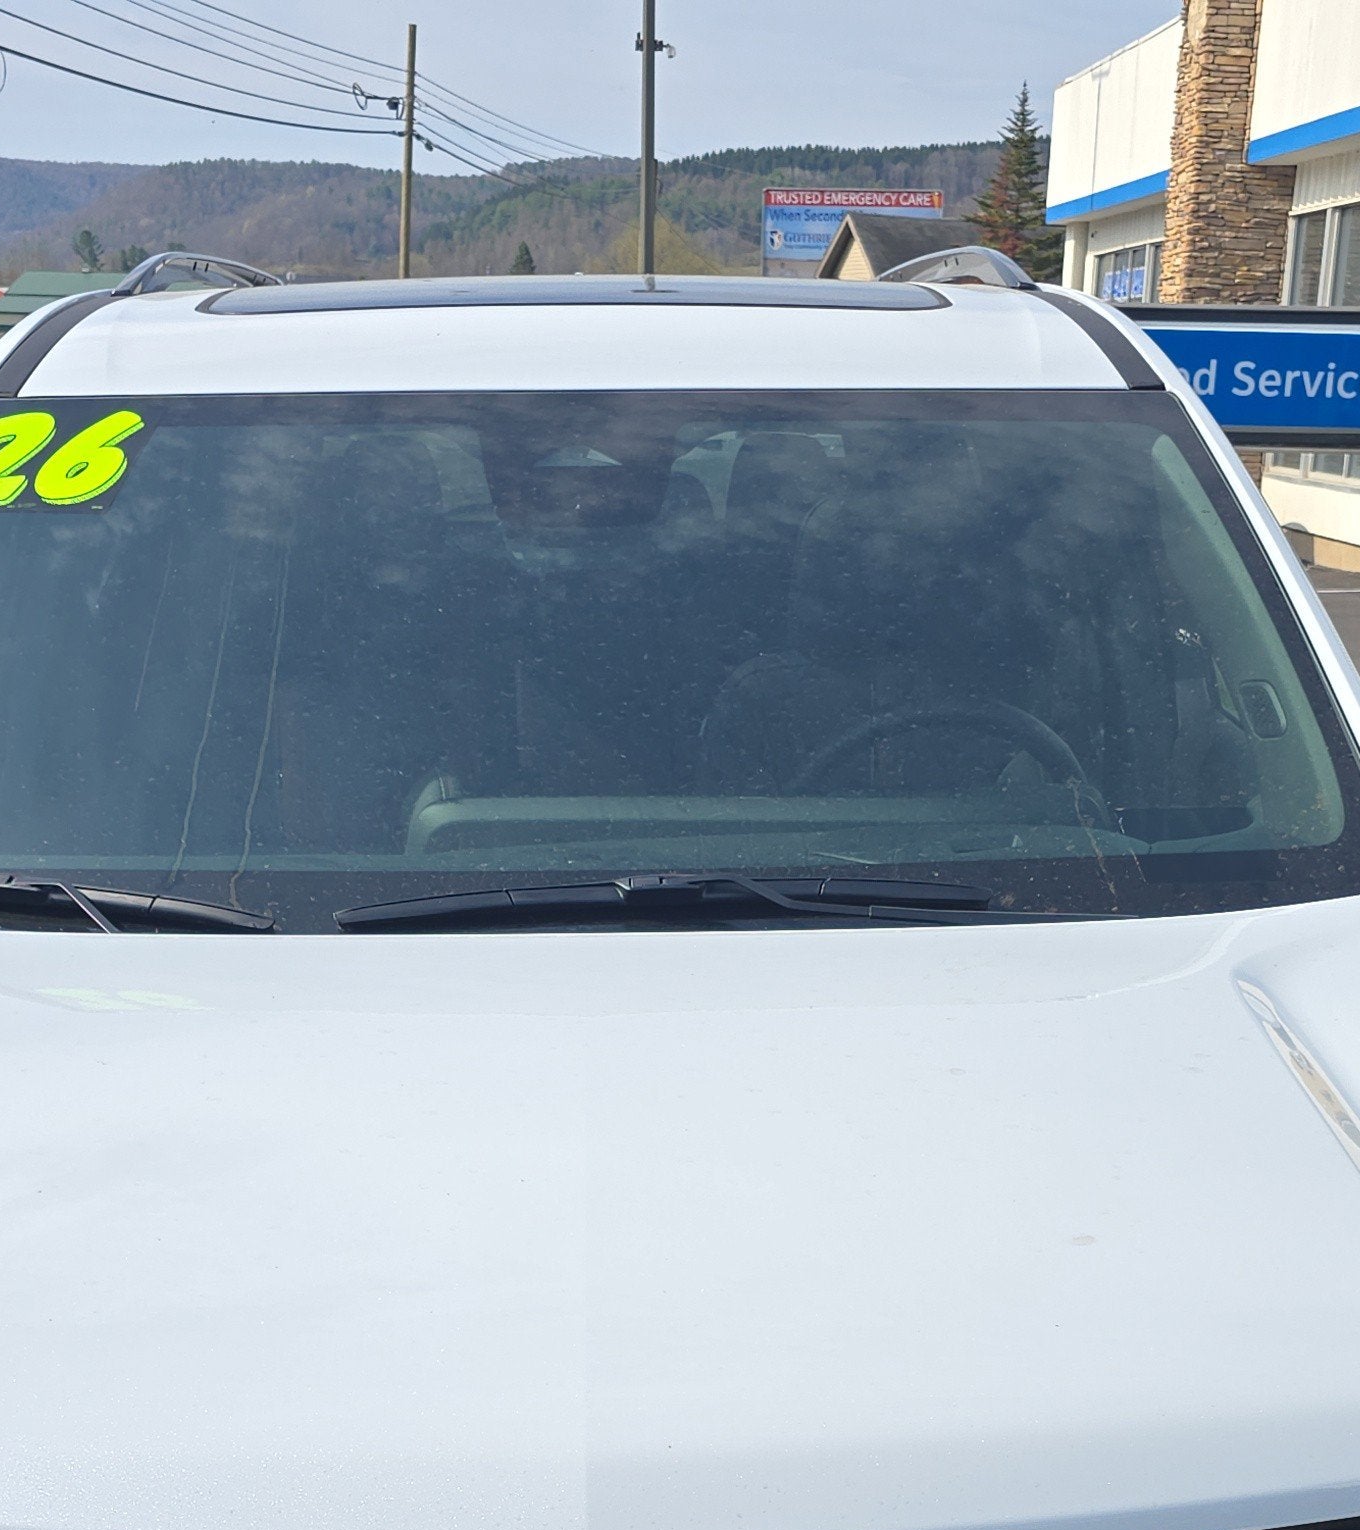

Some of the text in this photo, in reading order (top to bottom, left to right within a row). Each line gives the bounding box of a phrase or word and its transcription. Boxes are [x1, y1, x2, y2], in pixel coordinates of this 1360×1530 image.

[768, 191, 932, 206] TRUSTED EMERGENCY CARE
[769, 208, 801, 222] When
